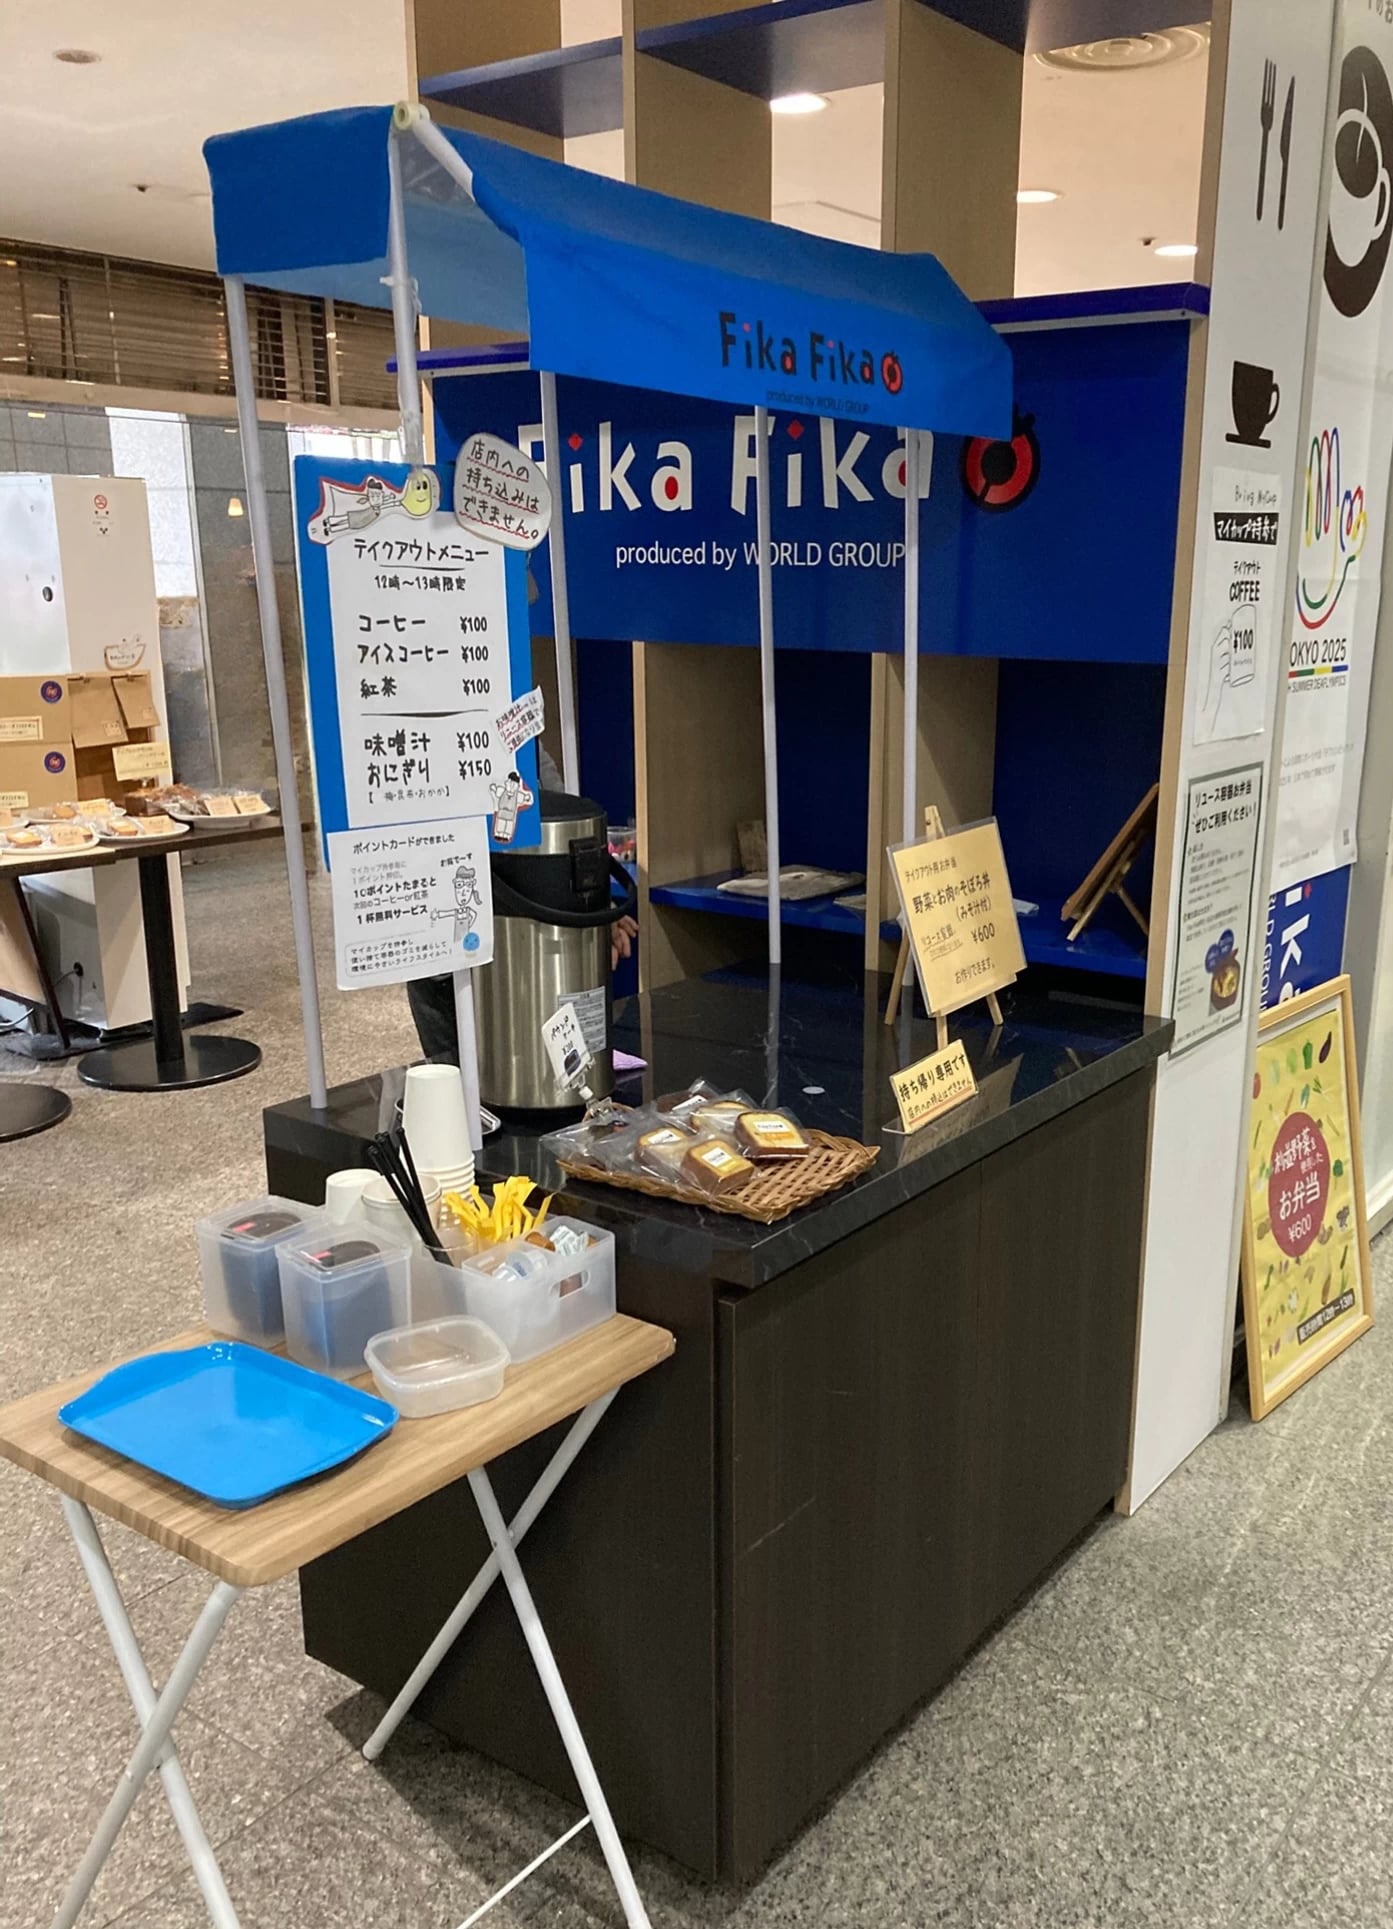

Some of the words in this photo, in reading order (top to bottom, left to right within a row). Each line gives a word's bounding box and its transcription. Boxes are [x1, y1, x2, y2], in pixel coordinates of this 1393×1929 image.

[719, 311, 798, 376] Fika
[809, 331, 876, 385] Fika
[470, 439, 529, 479] 店内への
[731, 415, 934, 516] Fika
[466, 467, 540, 512] 持ち込みは
[463, 495, 539, 540] できません。
[354, 538, 489, 562] テイクアウトメニュー
[616, 541, 706, 569] produced
[712, 542, 737, 570] by
[828, 541, 906, 567] GROUP
[1229, 580, 1260, 602] COFFEE
[358, 614, 426, 633] コーヒー
[459, 616, 488, 634] ¥100
[357, 642, 450, 665] アイスコーヒー
[461, 645, 489, 663] ¥100
[1233, 628, 1254, 654] ¥100
[1321, 637, 1347, 663] 2025
[360, 675, 397, 699] 紅茶
[462, 678, 491, 696] ¥100
[363, 728, 431, 757] 味噌汁
[456, 731, 489, 752] ¥100
[367, 757, 430, 788] おにぎり
[458, 758, 492, 780] ¥150
[353, 833, 455, 855] ポイントカードができました
[912, 871, 991, 914] 野菜とお肉のそぼろ丼
[970, 922, 996, 944] ¥600
[899, 1053, 966, 1103] 持ち帰り専用です
[1279, 1170, 1321, 1221] お弁当
[1287, 1213, 1313, 1243] ¥600
